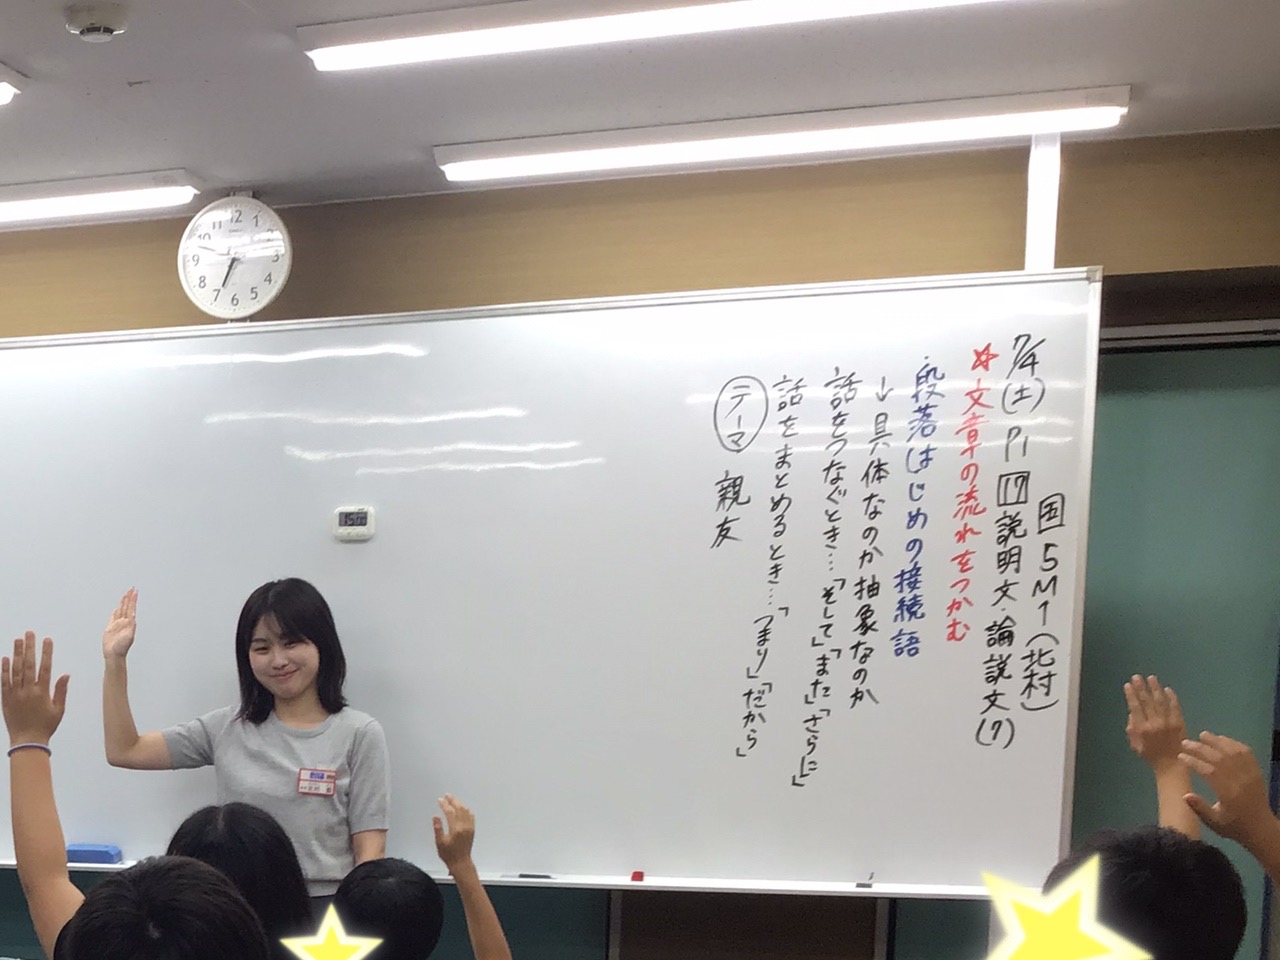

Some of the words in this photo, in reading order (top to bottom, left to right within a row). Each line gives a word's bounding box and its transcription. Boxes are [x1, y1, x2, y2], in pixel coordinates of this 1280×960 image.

[230, 210, 243, 223] 12
[253, 214, 260, 227] 1
[192, 254, 200, 266] 9
[198, 275, 206, 288] 8
[263, 272, 272, 285] 4
[212, 289, 220, 302] 7
[231, 293, 239, 306] 6
[250, 286, 258, 300] 5
[710, 470, 752, 549] 親友
[946, 377, 994, 642] 文章の流れをつかむ
